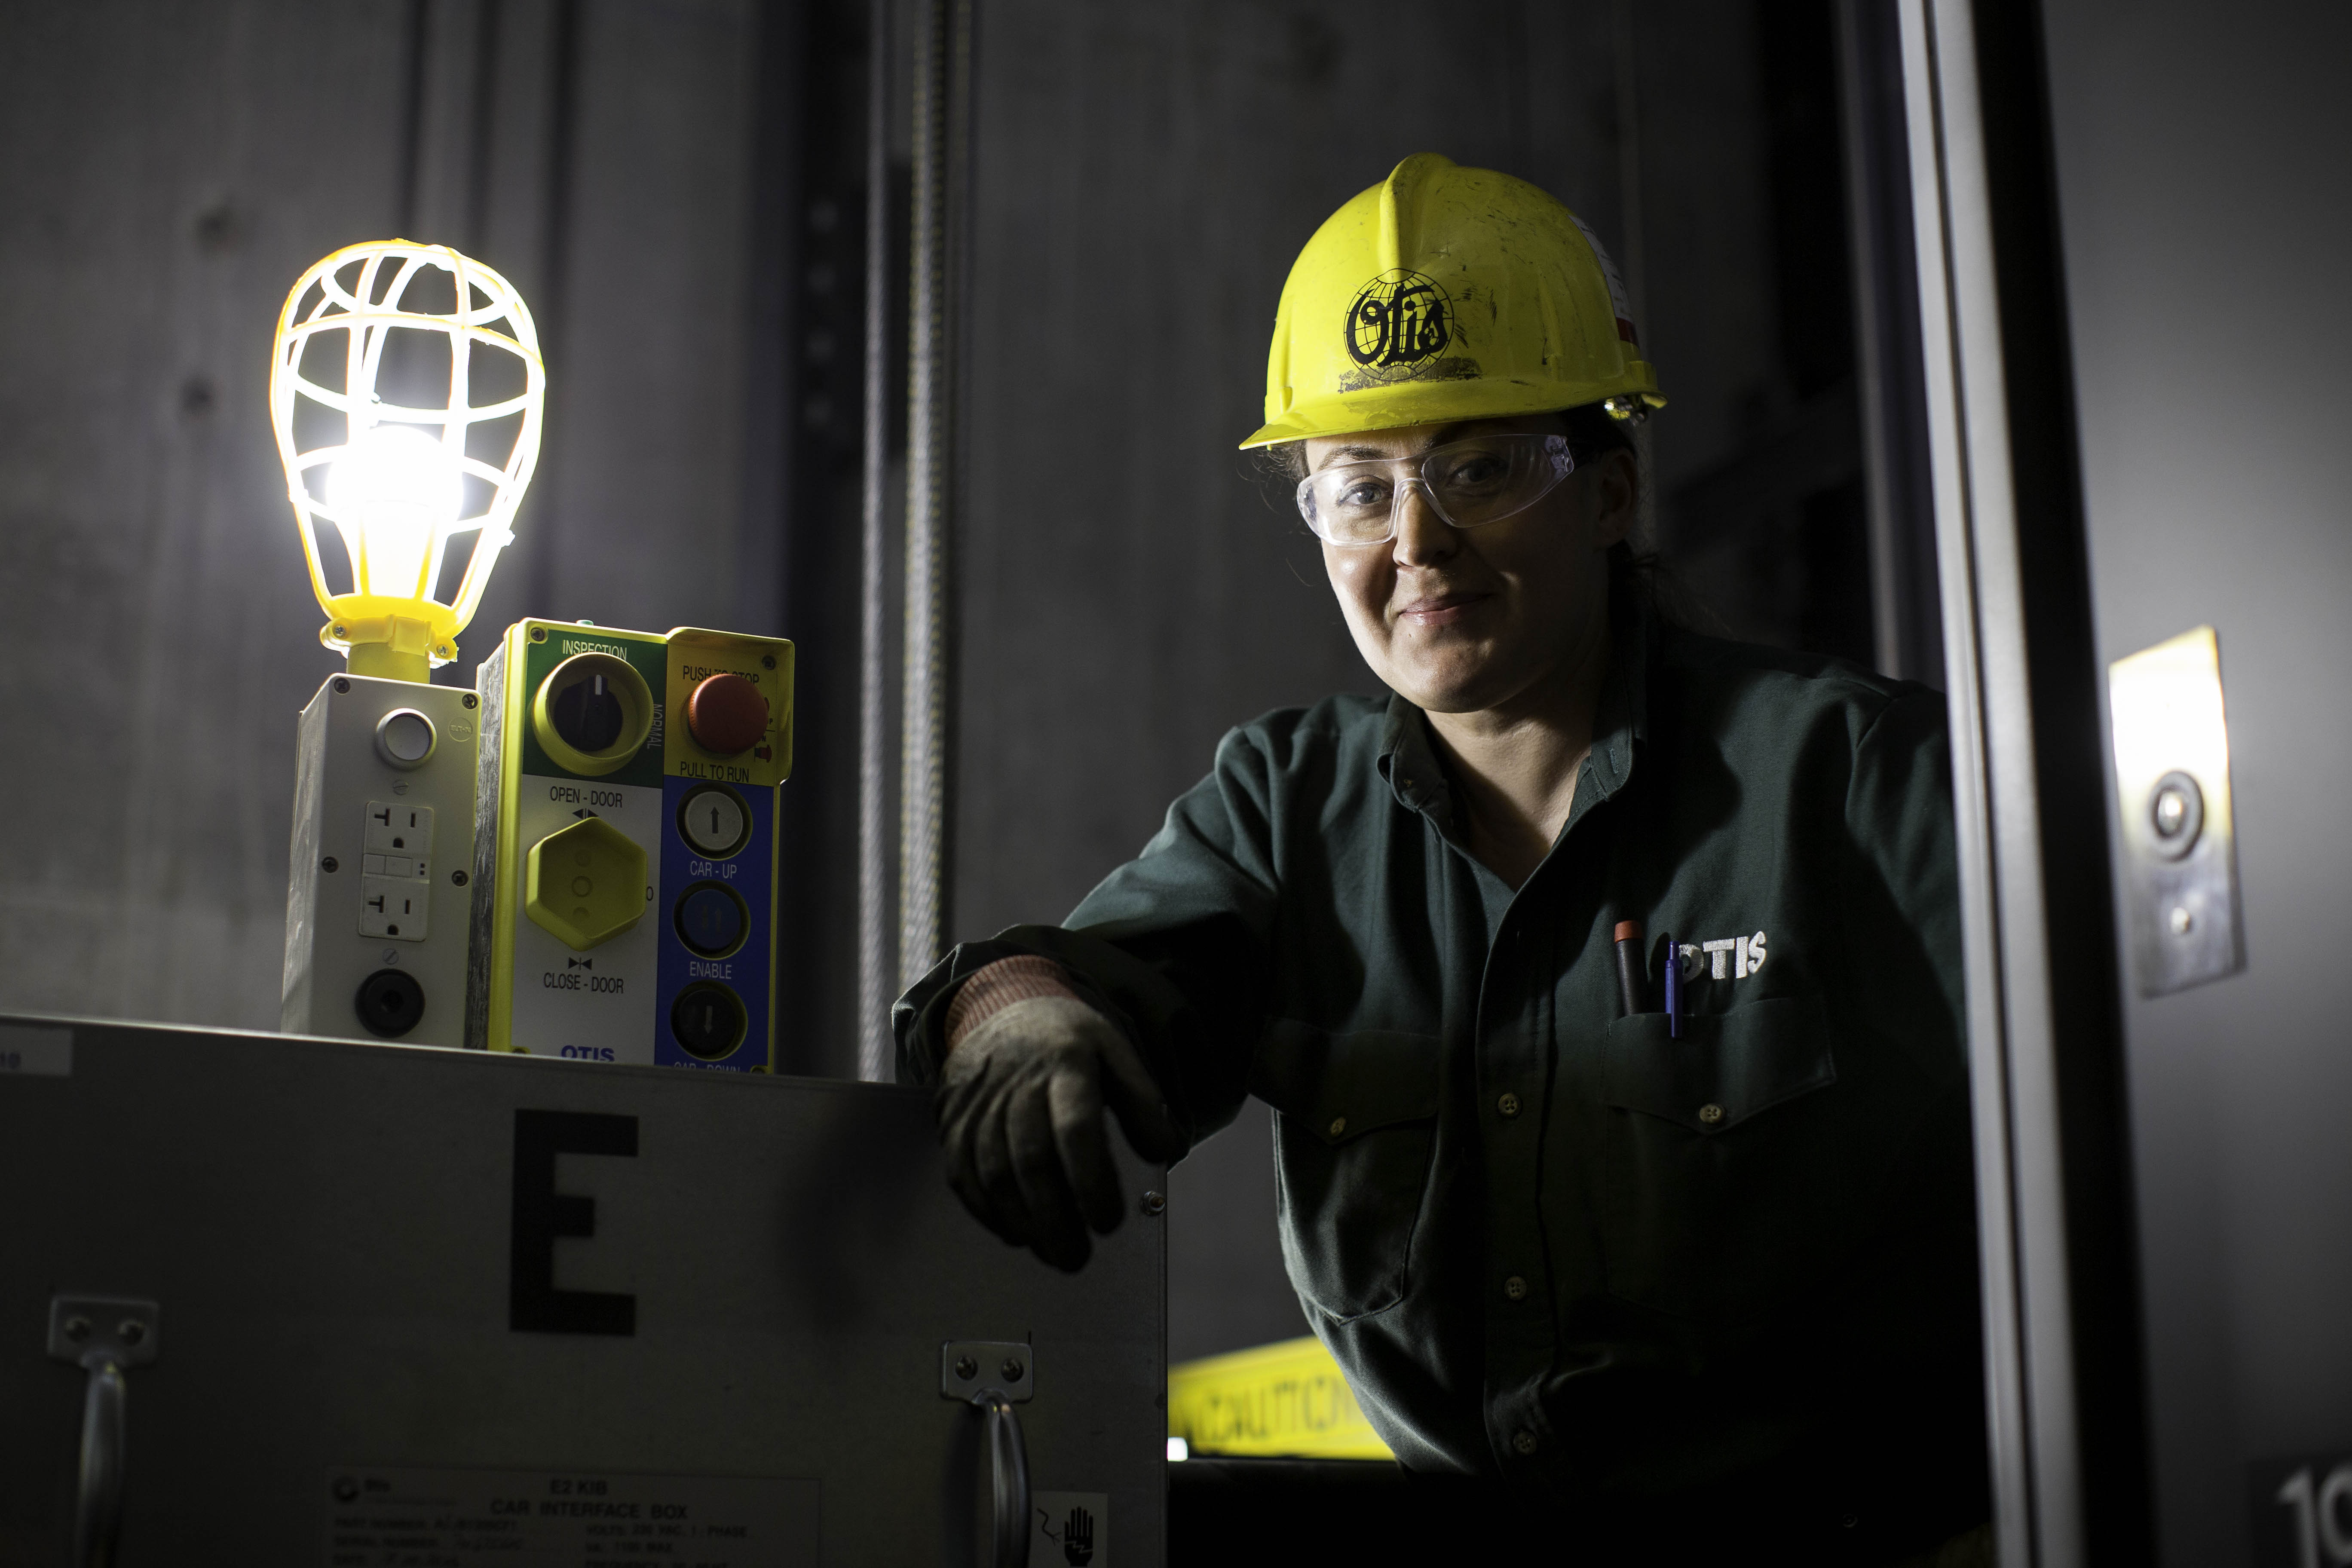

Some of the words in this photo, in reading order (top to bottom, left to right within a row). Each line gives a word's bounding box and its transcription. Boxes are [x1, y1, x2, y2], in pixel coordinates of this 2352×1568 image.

[1346, 283, 1448, 367] Otis
[562, 639, 627, 661] INSPECTION
[683, 665, 711, 682] PUSH
[646, 703, 664, 750] NORMAL
[680, 761, 707, 778] PULL
[710, 765, 724, 780] TO
[727, 766, 750, 783] RUN
[550, 786, 580, 803] OPEN
[591, 790, 623, 808] DOOR
[690, 861, 712, 877] CAR
[722, 864, 737, 879] UP
[689, 961, 732, 980] ENABLE
[544, 972, 581, 990] CLOSE
[591, 976, 624, 994] DOOR
[561, 1045, 615, 1062] OTIS
[510, 1109, 639, 1338] E
[550, 1479, 573, 1495] E2
[578, 1480, 607, 1496] KIB
[490, 1498, 530, 1516] CAR
[539, 1501, 640, 1519] INTERFACE
[652, 1503, 688, 1520] BOX
